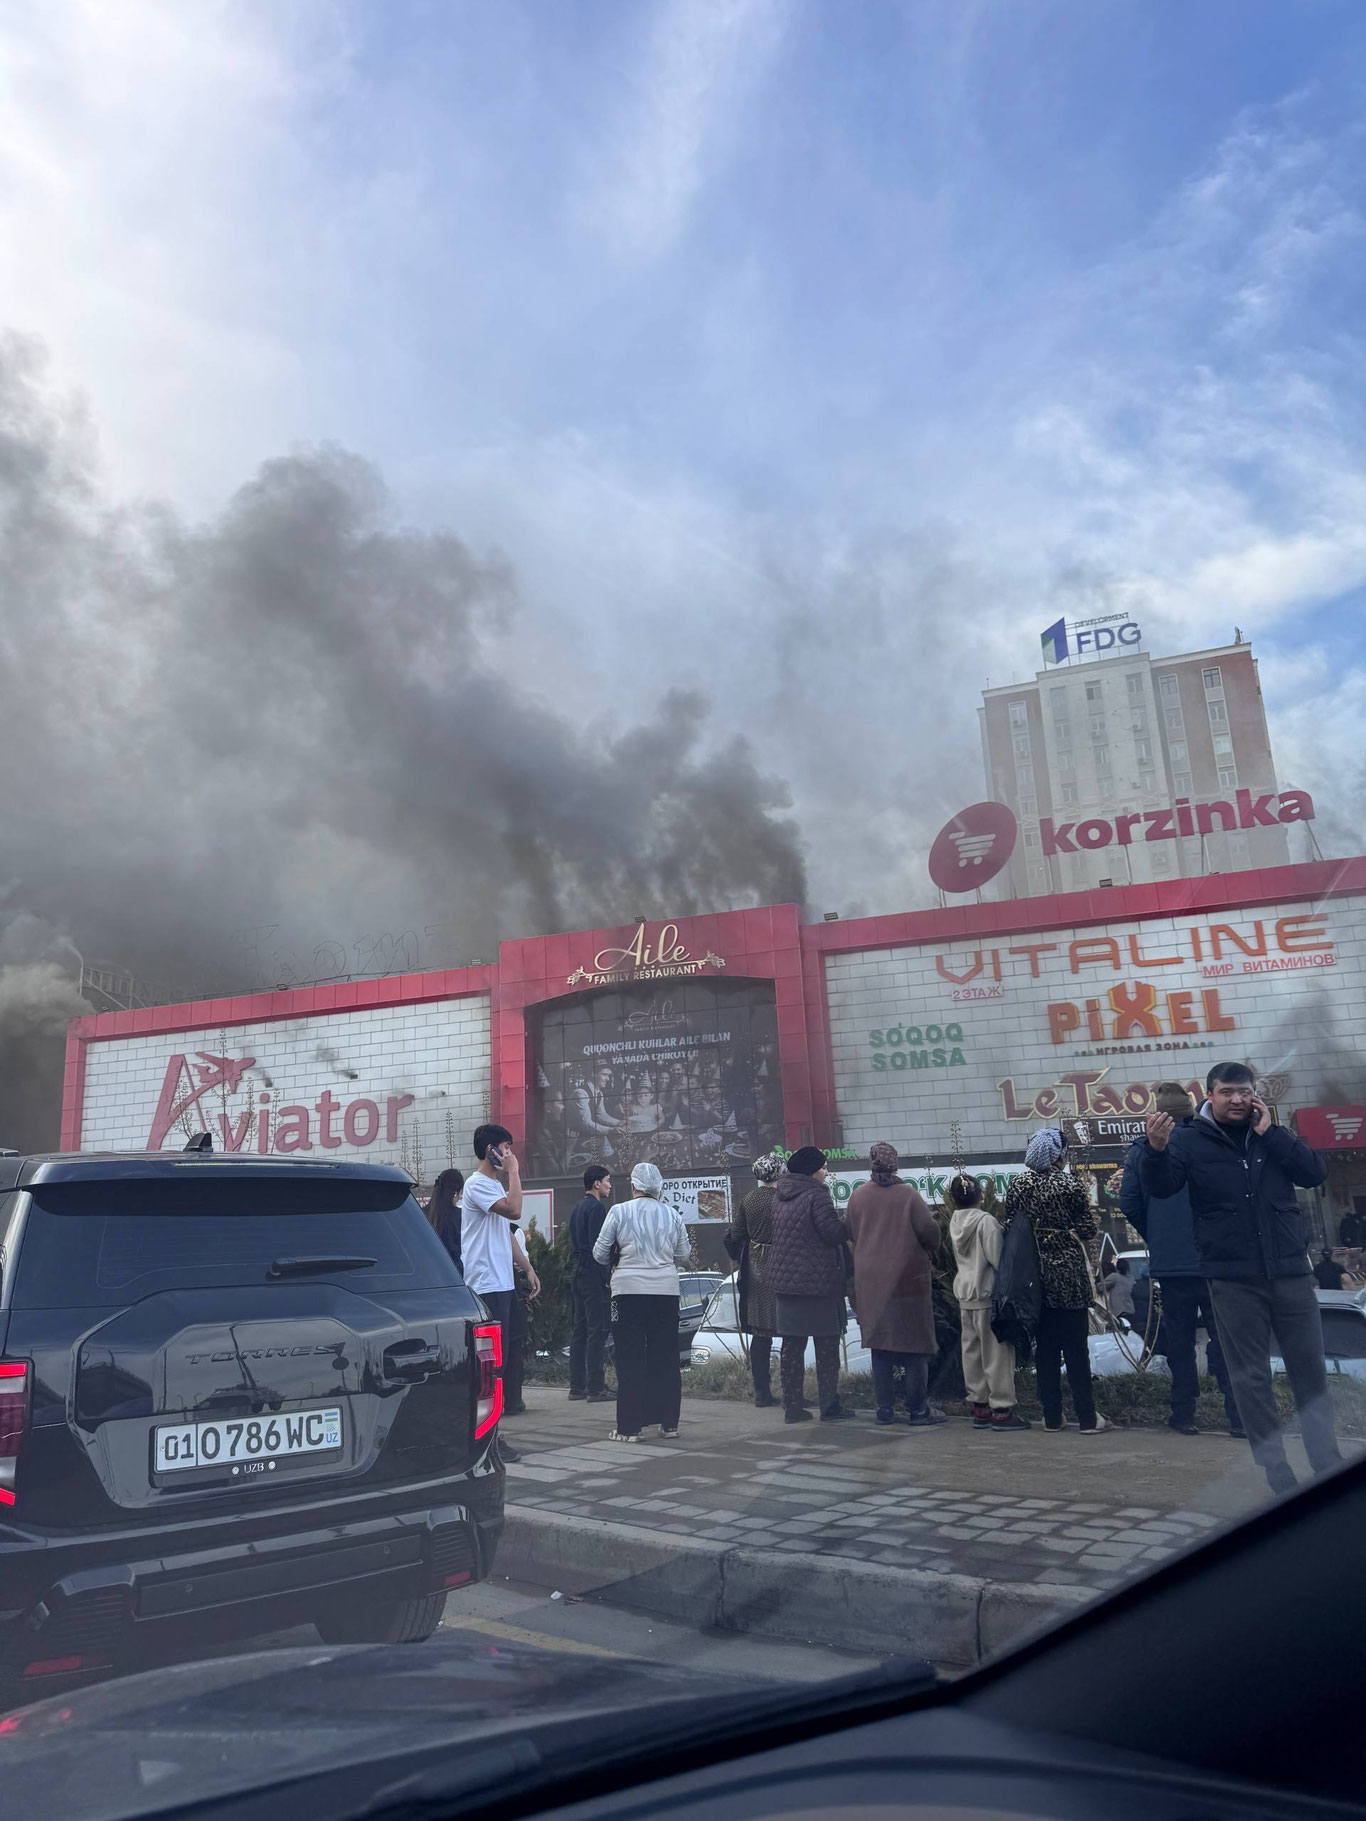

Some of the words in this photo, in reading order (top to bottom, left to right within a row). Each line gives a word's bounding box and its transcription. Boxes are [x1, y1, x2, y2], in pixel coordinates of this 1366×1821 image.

[1077, 622, 1142, 654] FDG
[1039, 789, 1315, 855] korzinka
[594, 922, 690, 971] Aile
[936, 914, 1334, 985] VITALINE
[594, 971, 630, 985] FAMILY
[633, 964, 697, 981] RESTAURANT
[1203, 963, 1234, 976] МИР
[1243, 953, 1335, 973] ВИТАМИНОВ
[953, 990, 961, 1000] 2
[963, 986, 1001, 999] ЭТАЖ
[872, 1047, 967, 1072] SOMSA
[1096, 1044, 1151, 1056] ИГРОВАЯ
[1155, 1041, 1190, 1052] ЗОНА
[146, 1053, 415, 1154] Aviator
[1098, 1119, 1147, 1135] Emirat
[681, 1179, 728, 1190] ОТКРЫТИЕ
[185, 1342, 346, 1364] TORRES
[165, 1433, 195, 1460] 01
[326, 1432, 339, 1444] UZ
[244, 1462, 265, 1473] UZB
